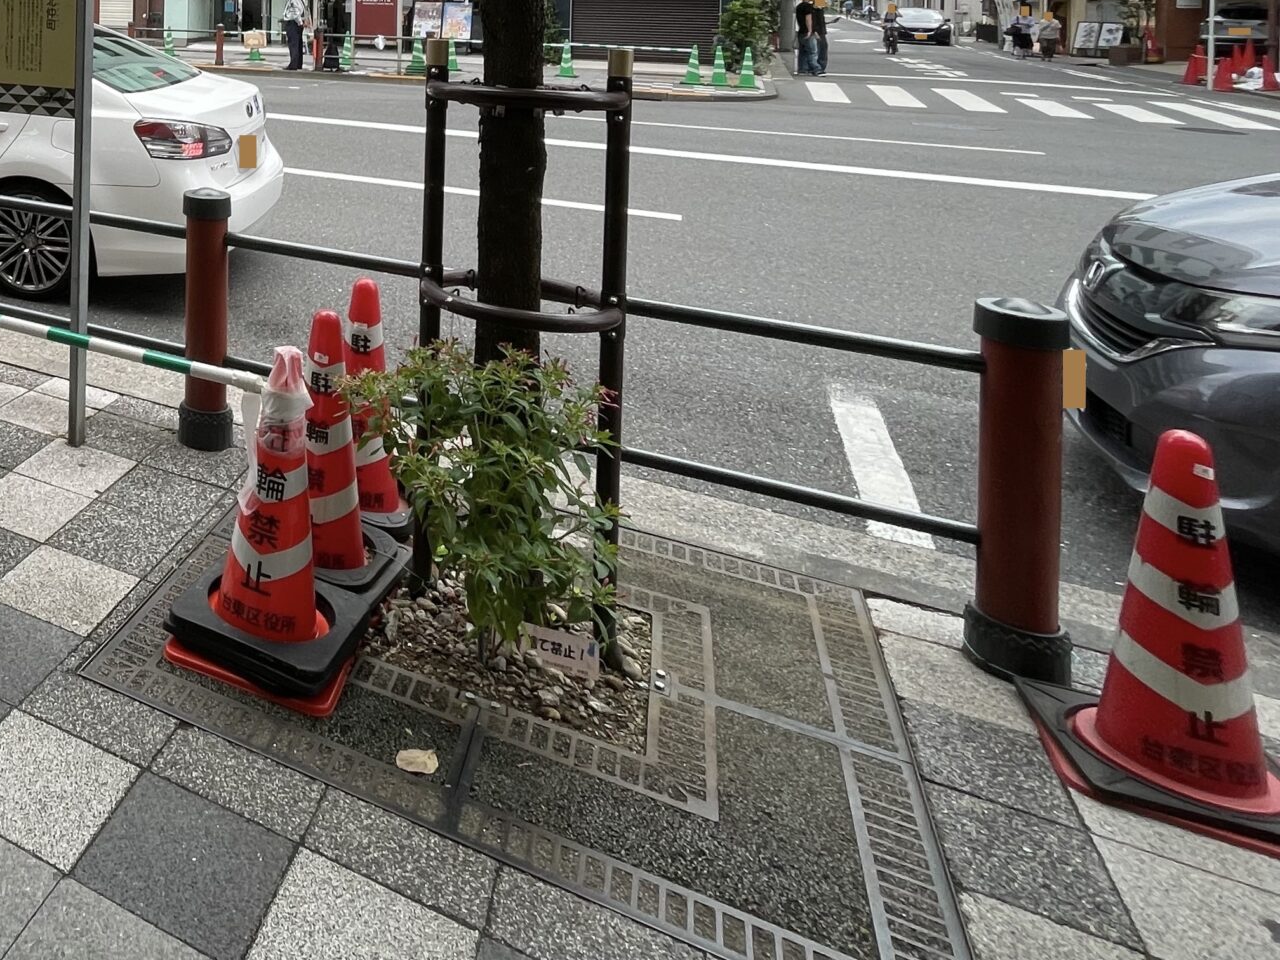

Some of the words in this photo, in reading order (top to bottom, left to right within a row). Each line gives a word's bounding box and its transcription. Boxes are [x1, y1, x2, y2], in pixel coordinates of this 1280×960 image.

[221, 594, 297, 634] 台東区役所
[1177, 515, 1228, 746] 駐輪禁止
